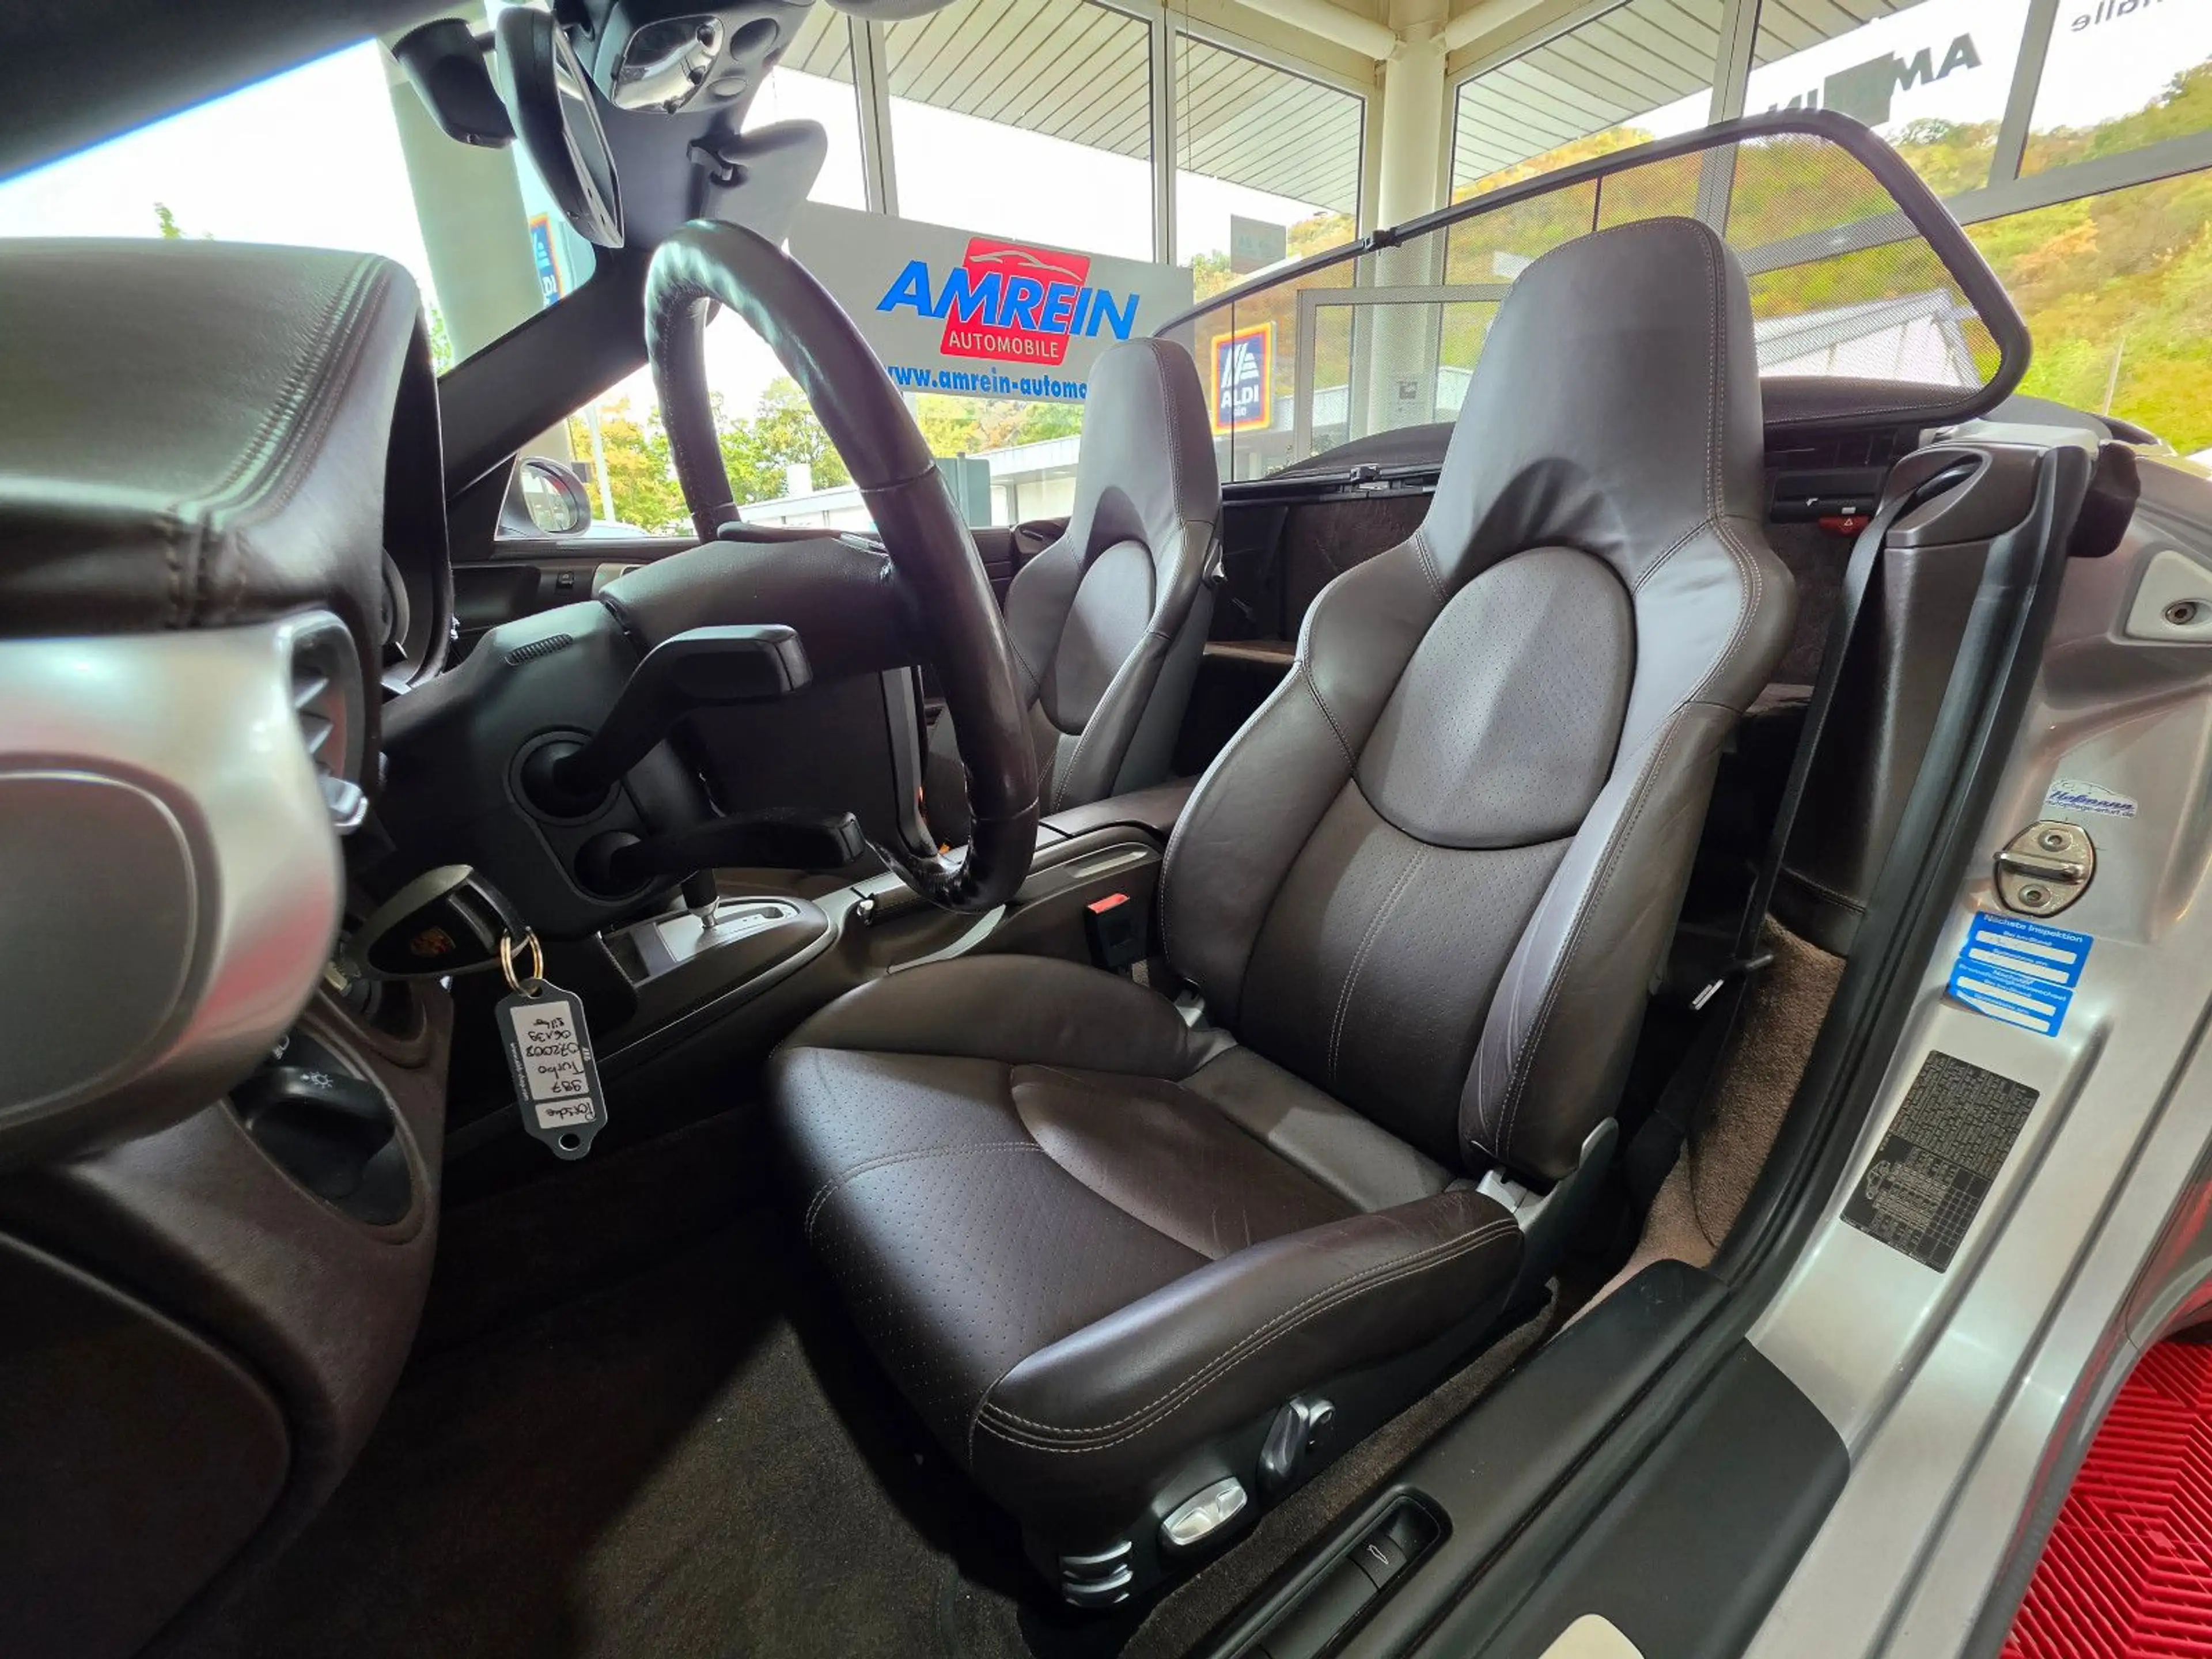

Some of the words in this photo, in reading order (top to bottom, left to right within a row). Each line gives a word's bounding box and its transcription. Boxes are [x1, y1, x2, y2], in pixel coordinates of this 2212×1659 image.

[876, 260, 1140, 340] AMREIN
[949, 330, 1059, 358] AUTOMOBILE
[1221, 384, 1259, 408] ALDI
[2028, 925, 2083, 943] Inspektion
[538, 1062, 584, 1079] Turbo
